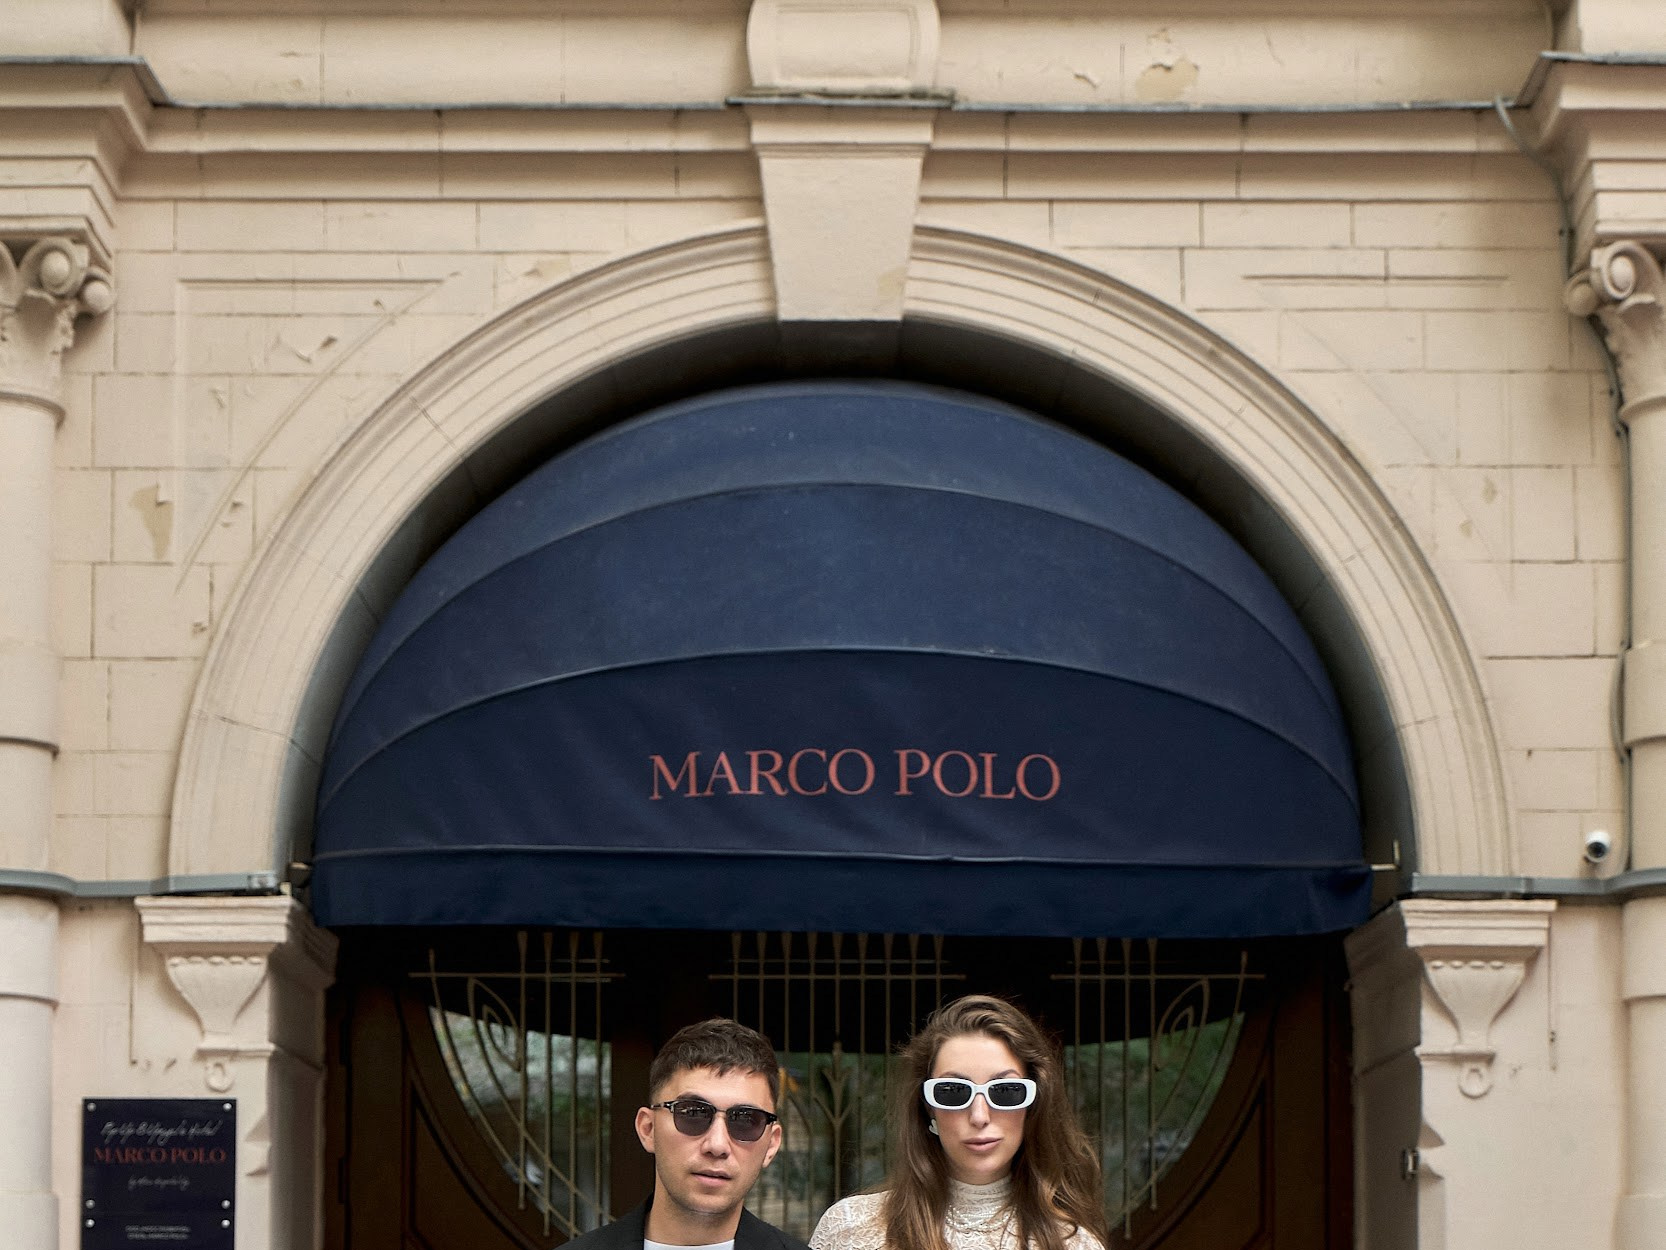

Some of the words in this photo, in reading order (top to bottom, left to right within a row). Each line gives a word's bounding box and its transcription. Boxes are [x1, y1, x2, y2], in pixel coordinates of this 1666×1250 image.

[649, 748, 876, 800] MARCO
[894, 748, 1062, 801] POLO
[94, 1146, 168, 1165] MARCO
[171, 1146, 227, 1164] POLO
